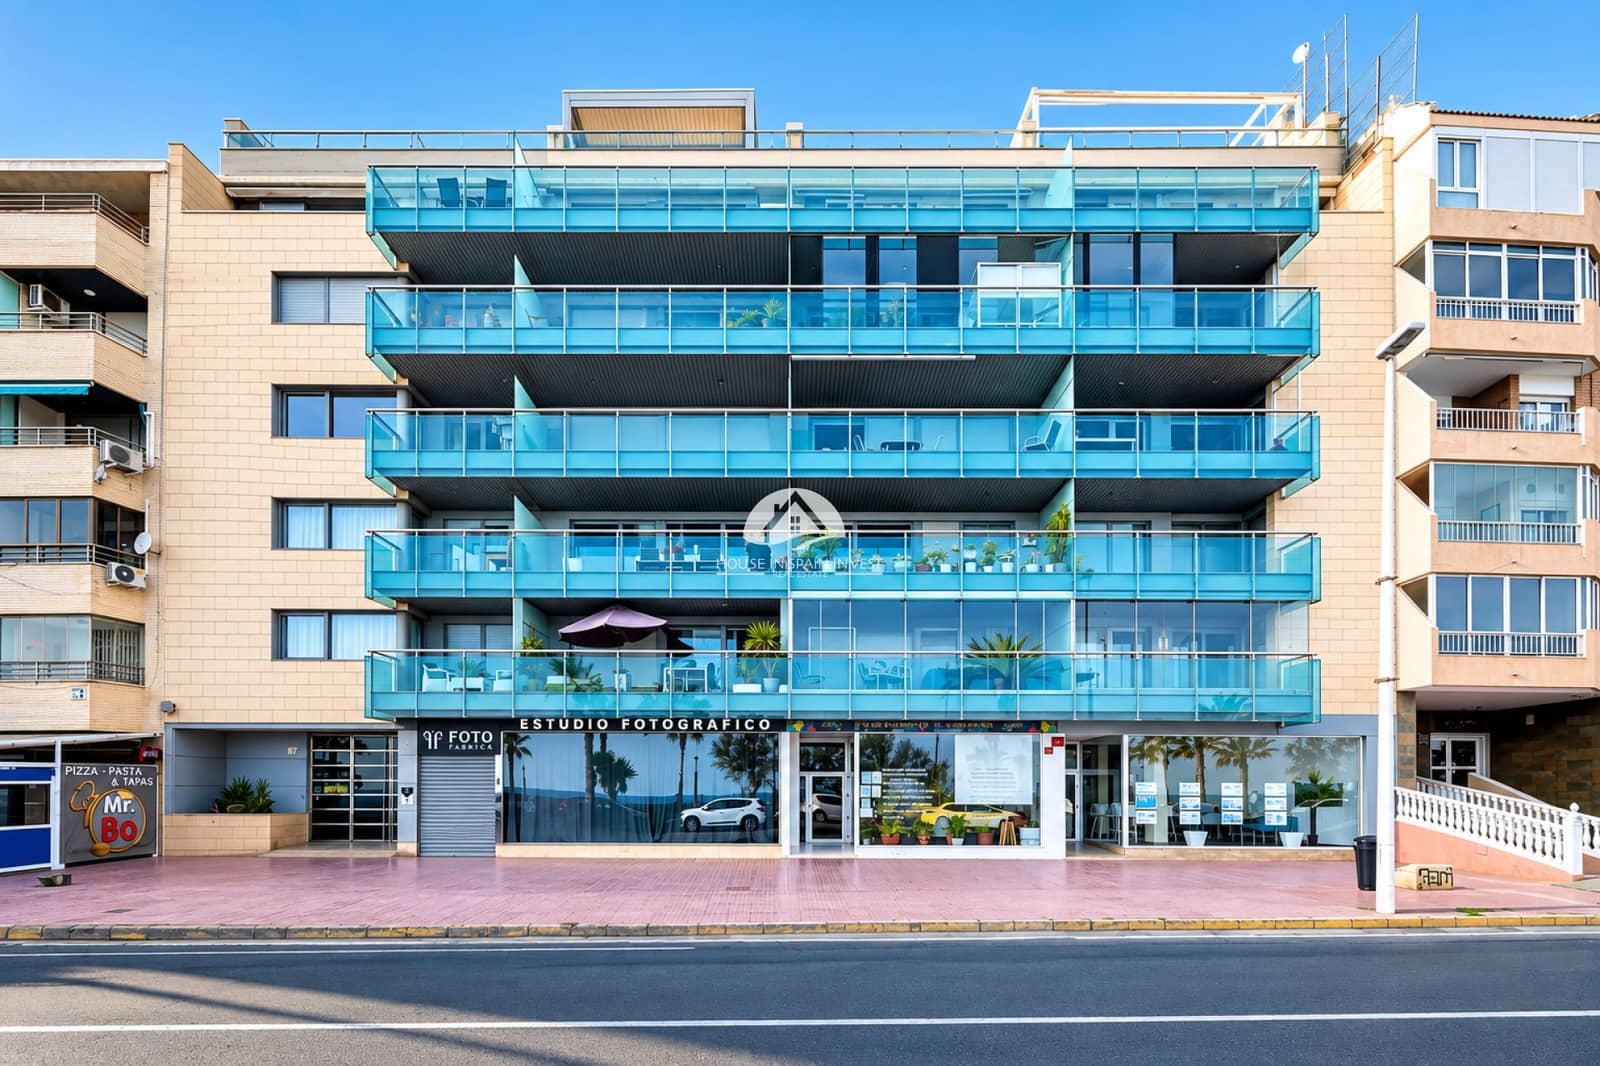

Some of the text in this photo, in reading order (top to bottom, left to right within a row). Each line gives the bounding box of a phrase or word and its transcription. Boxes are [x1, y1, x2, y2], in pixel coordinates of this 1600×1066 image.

[519, 718, 771, 730] ESTUDIO FOTOGRAFICO
[448, 730, 493, 744] FOTO
[64, 765, 143, 776] PIZZA PASTA
[111, 777, 154, 787] & TAPAS
[103, 796, 136, 814] Mr.
[101, 816, 138, 843] Bo
